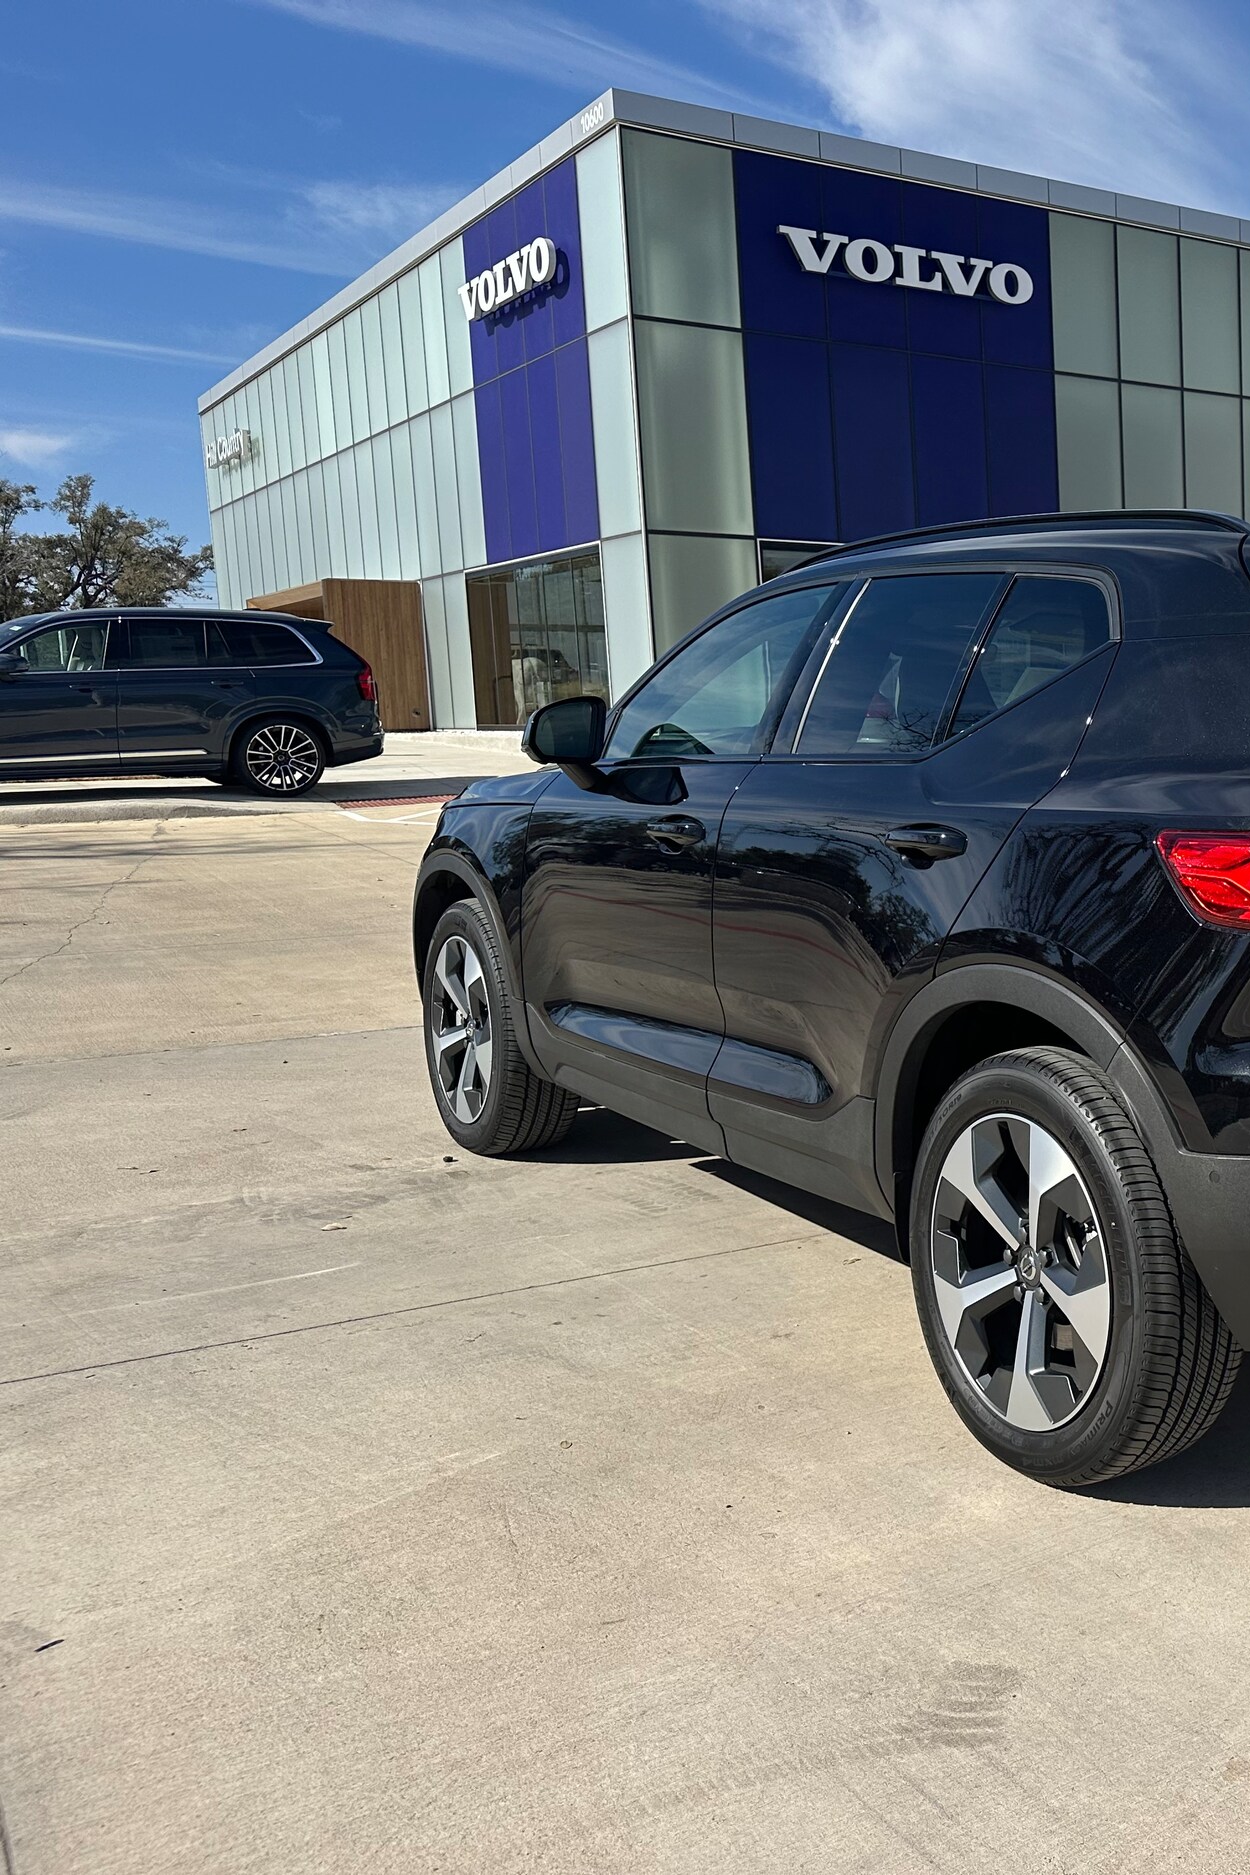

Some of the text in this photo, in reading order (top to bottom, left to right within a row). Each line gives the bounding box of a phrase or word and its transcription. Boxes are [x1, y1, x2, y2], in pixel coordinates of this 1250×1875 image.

[580, 102, 604, 134] 10600
[457, 236, 556, 321] VOLVO
[776, 225, 1034, 305] VOLVO
[217, 426, 244, 461] Country
